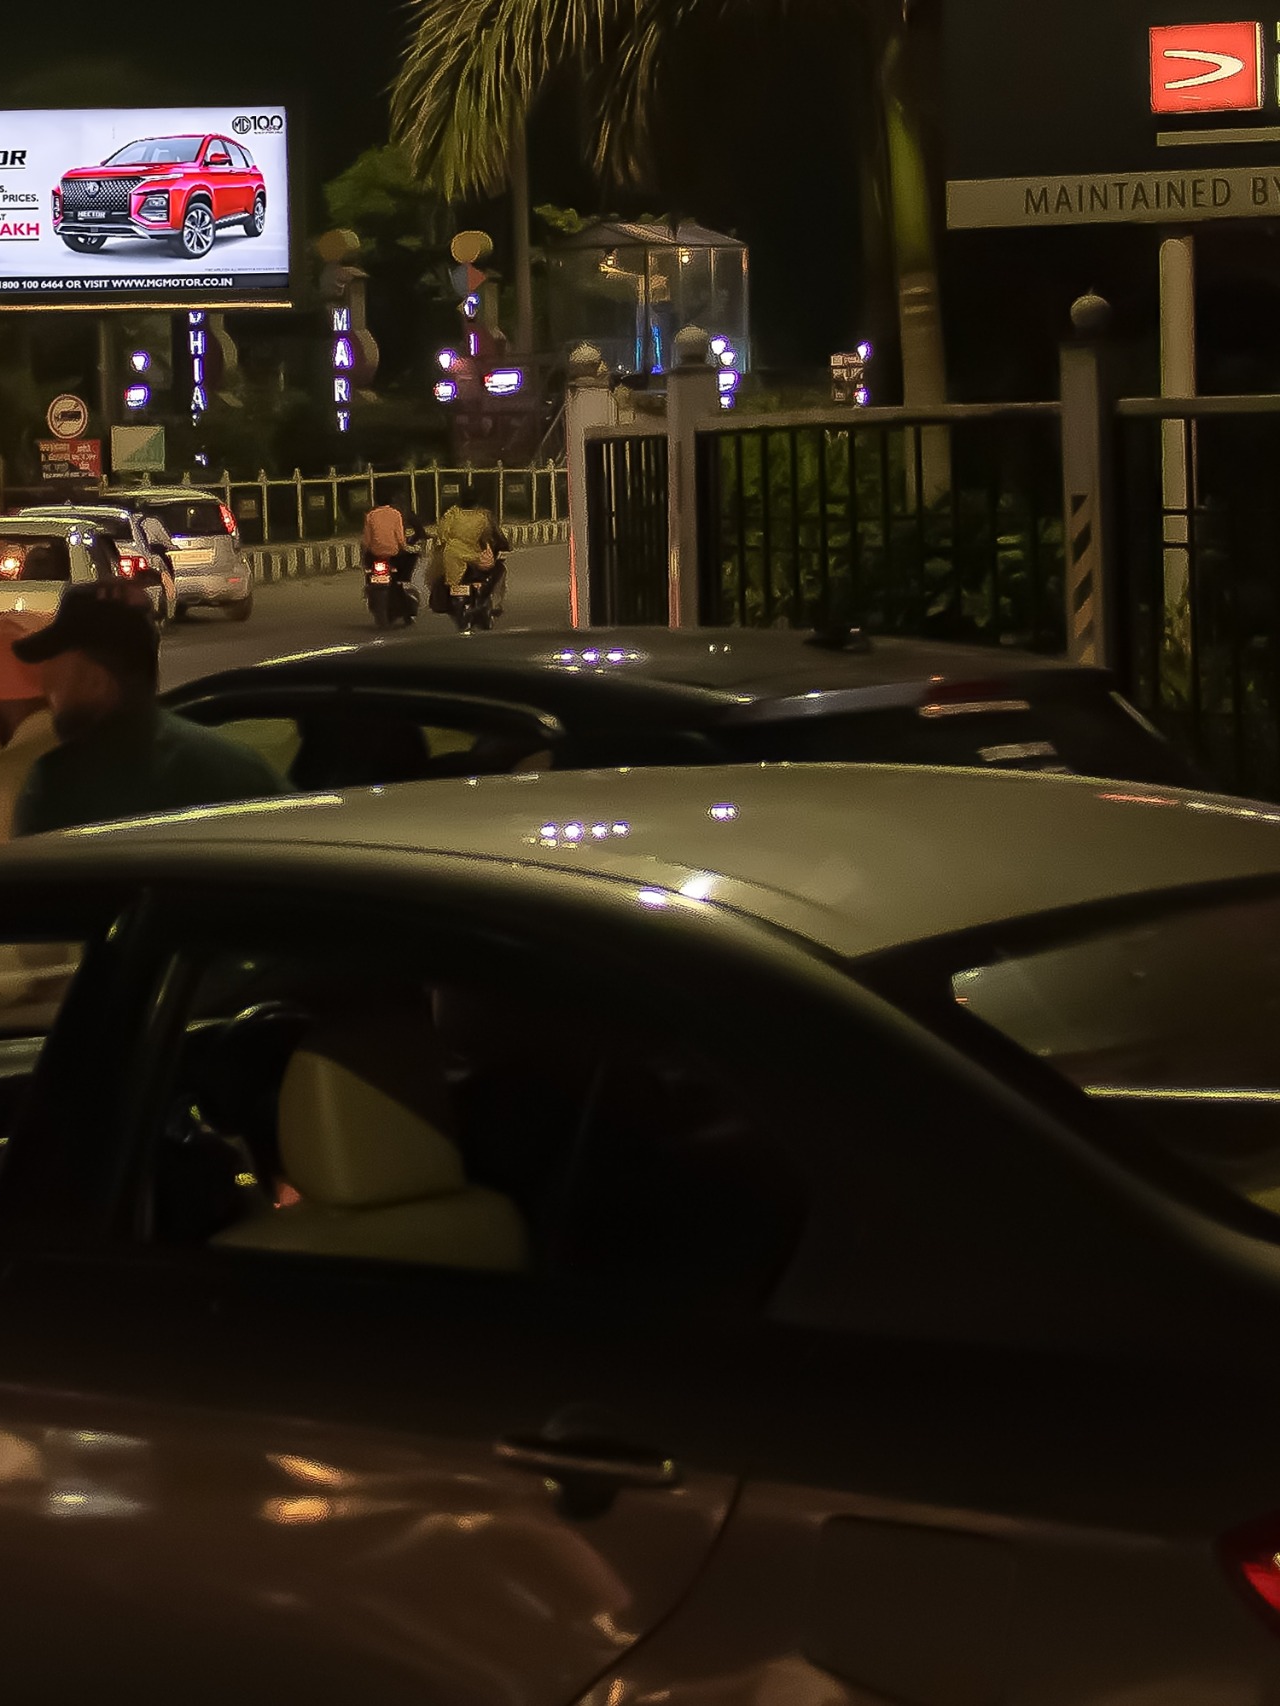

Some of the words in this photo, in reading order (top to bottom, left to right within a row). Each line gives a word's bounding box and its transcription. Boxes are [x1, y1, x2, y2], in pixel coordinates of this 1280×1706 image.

[234, 118, 249, 132] MG
[2, 194, 39, 202] PRICES.
[1024, 178, 1232, 214] MAINTAINED
[22, 280, 39, 288] 100
[40, 280, 64, 289] 6464
[65, 280, 82, 288] OR
[83, 280, 110, 288] VISIT
[111, 278, 233, 288] WWW.MGMOTOR.CO.IN
